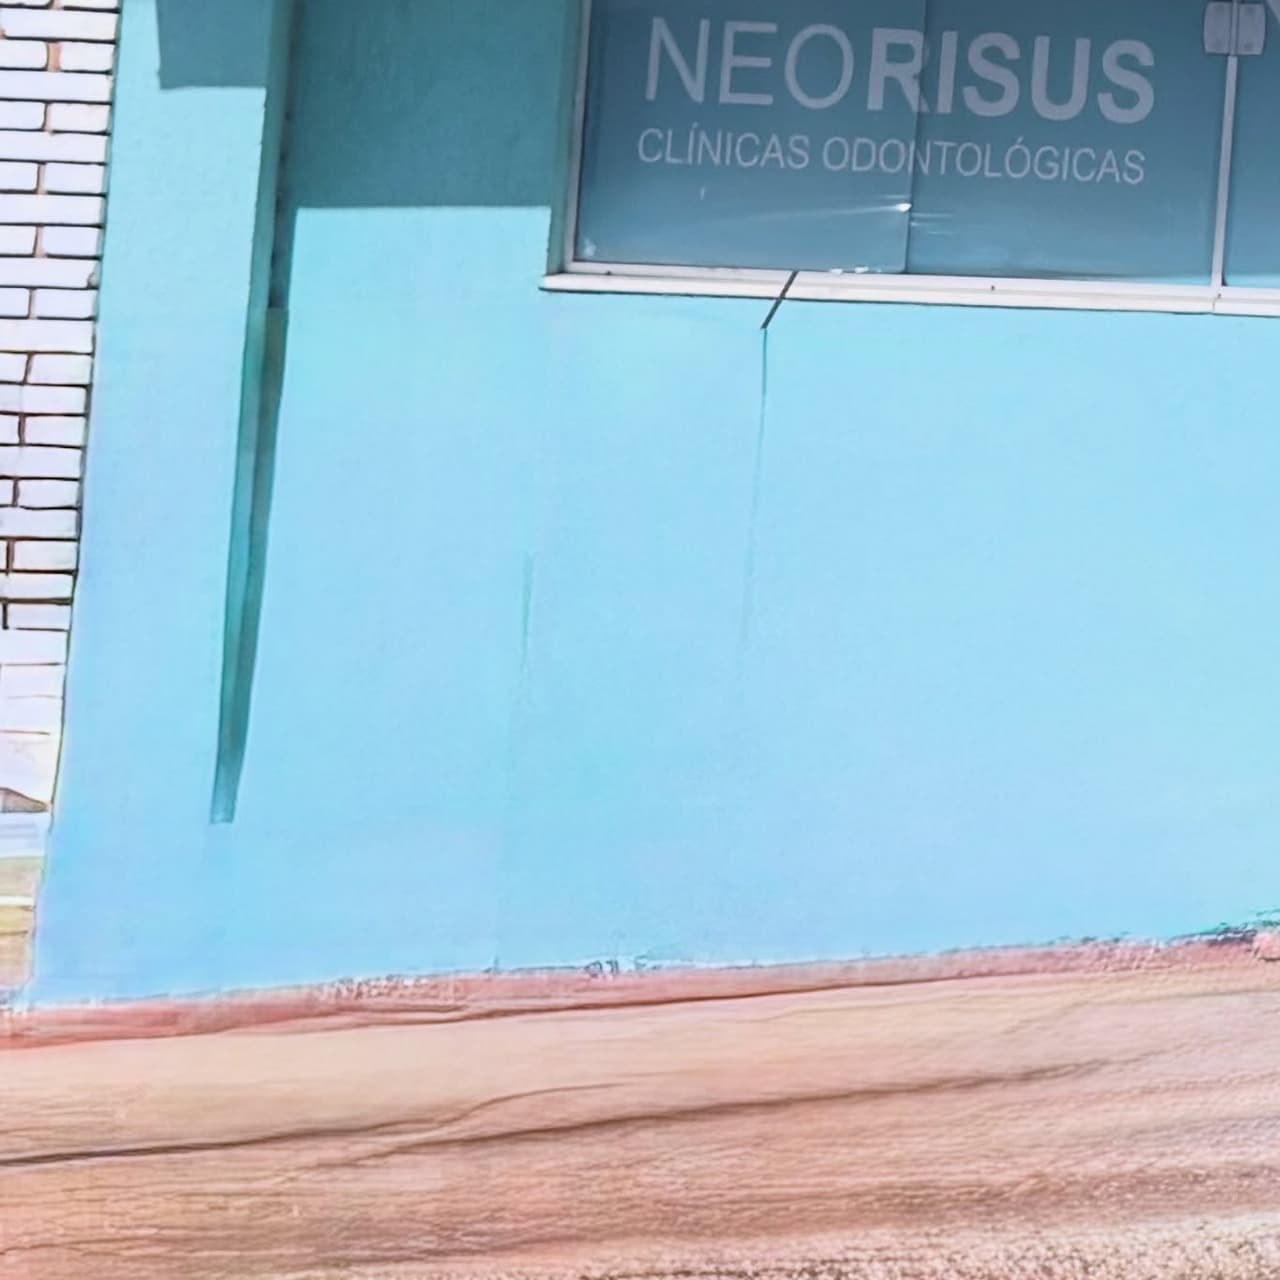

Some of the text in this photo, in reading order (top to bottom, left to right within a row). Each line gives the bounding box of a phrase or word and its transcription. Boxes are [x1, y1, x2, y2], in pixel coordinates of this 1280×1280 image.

[644, 16, 1156, 124] NEORISUS
[637, 122, 1146, 185] CLÍNICAS ODONTOLÓGICAS
